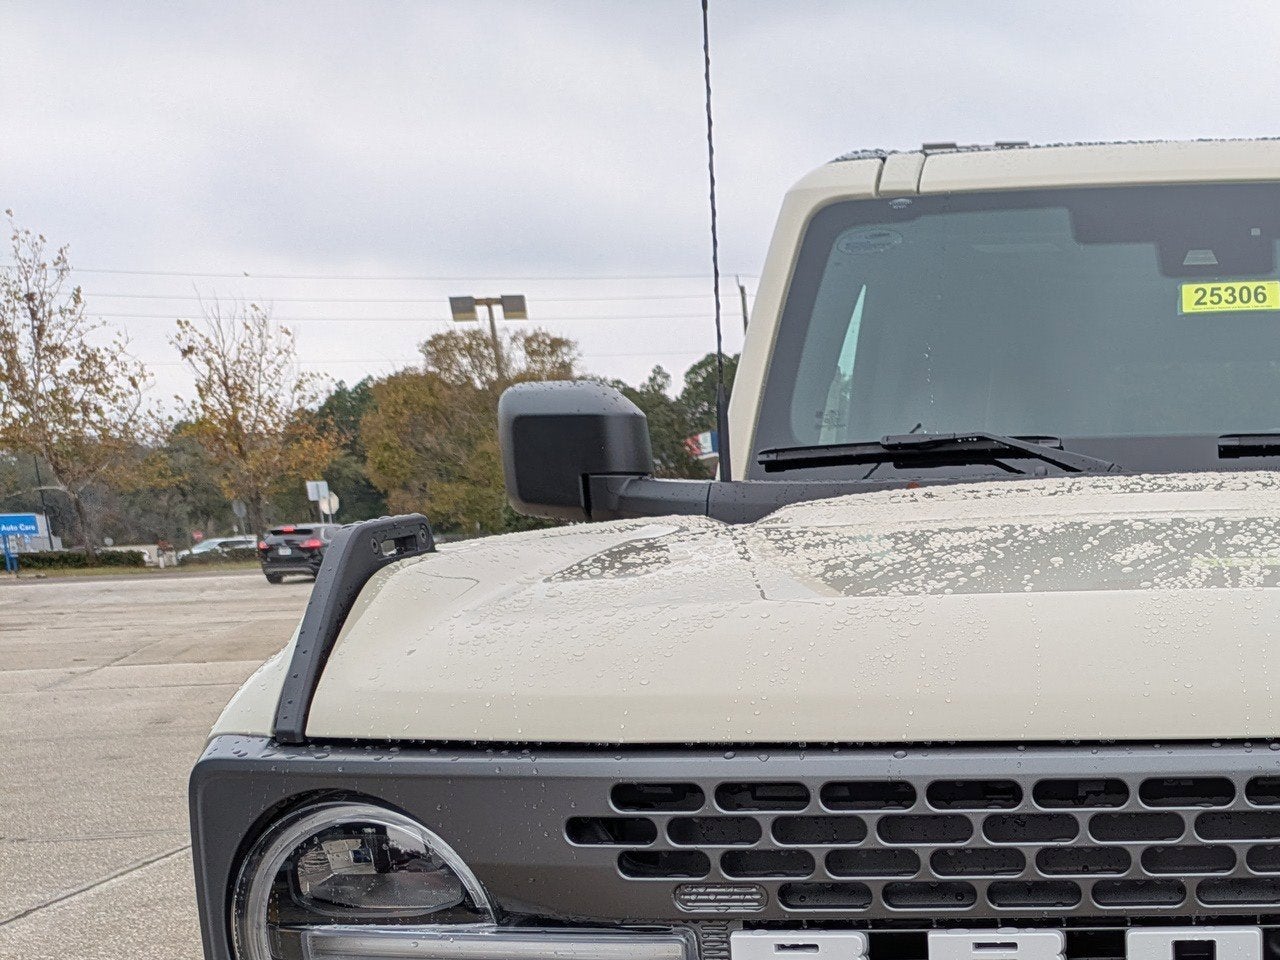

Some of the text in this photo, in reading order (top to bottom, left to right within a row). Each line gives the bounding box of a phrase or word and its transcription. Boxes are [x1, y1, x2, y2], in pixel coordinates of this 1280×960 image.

[1193, 285, 1268, 306] 25306
[1, 523, 36, 531] Auto Care
